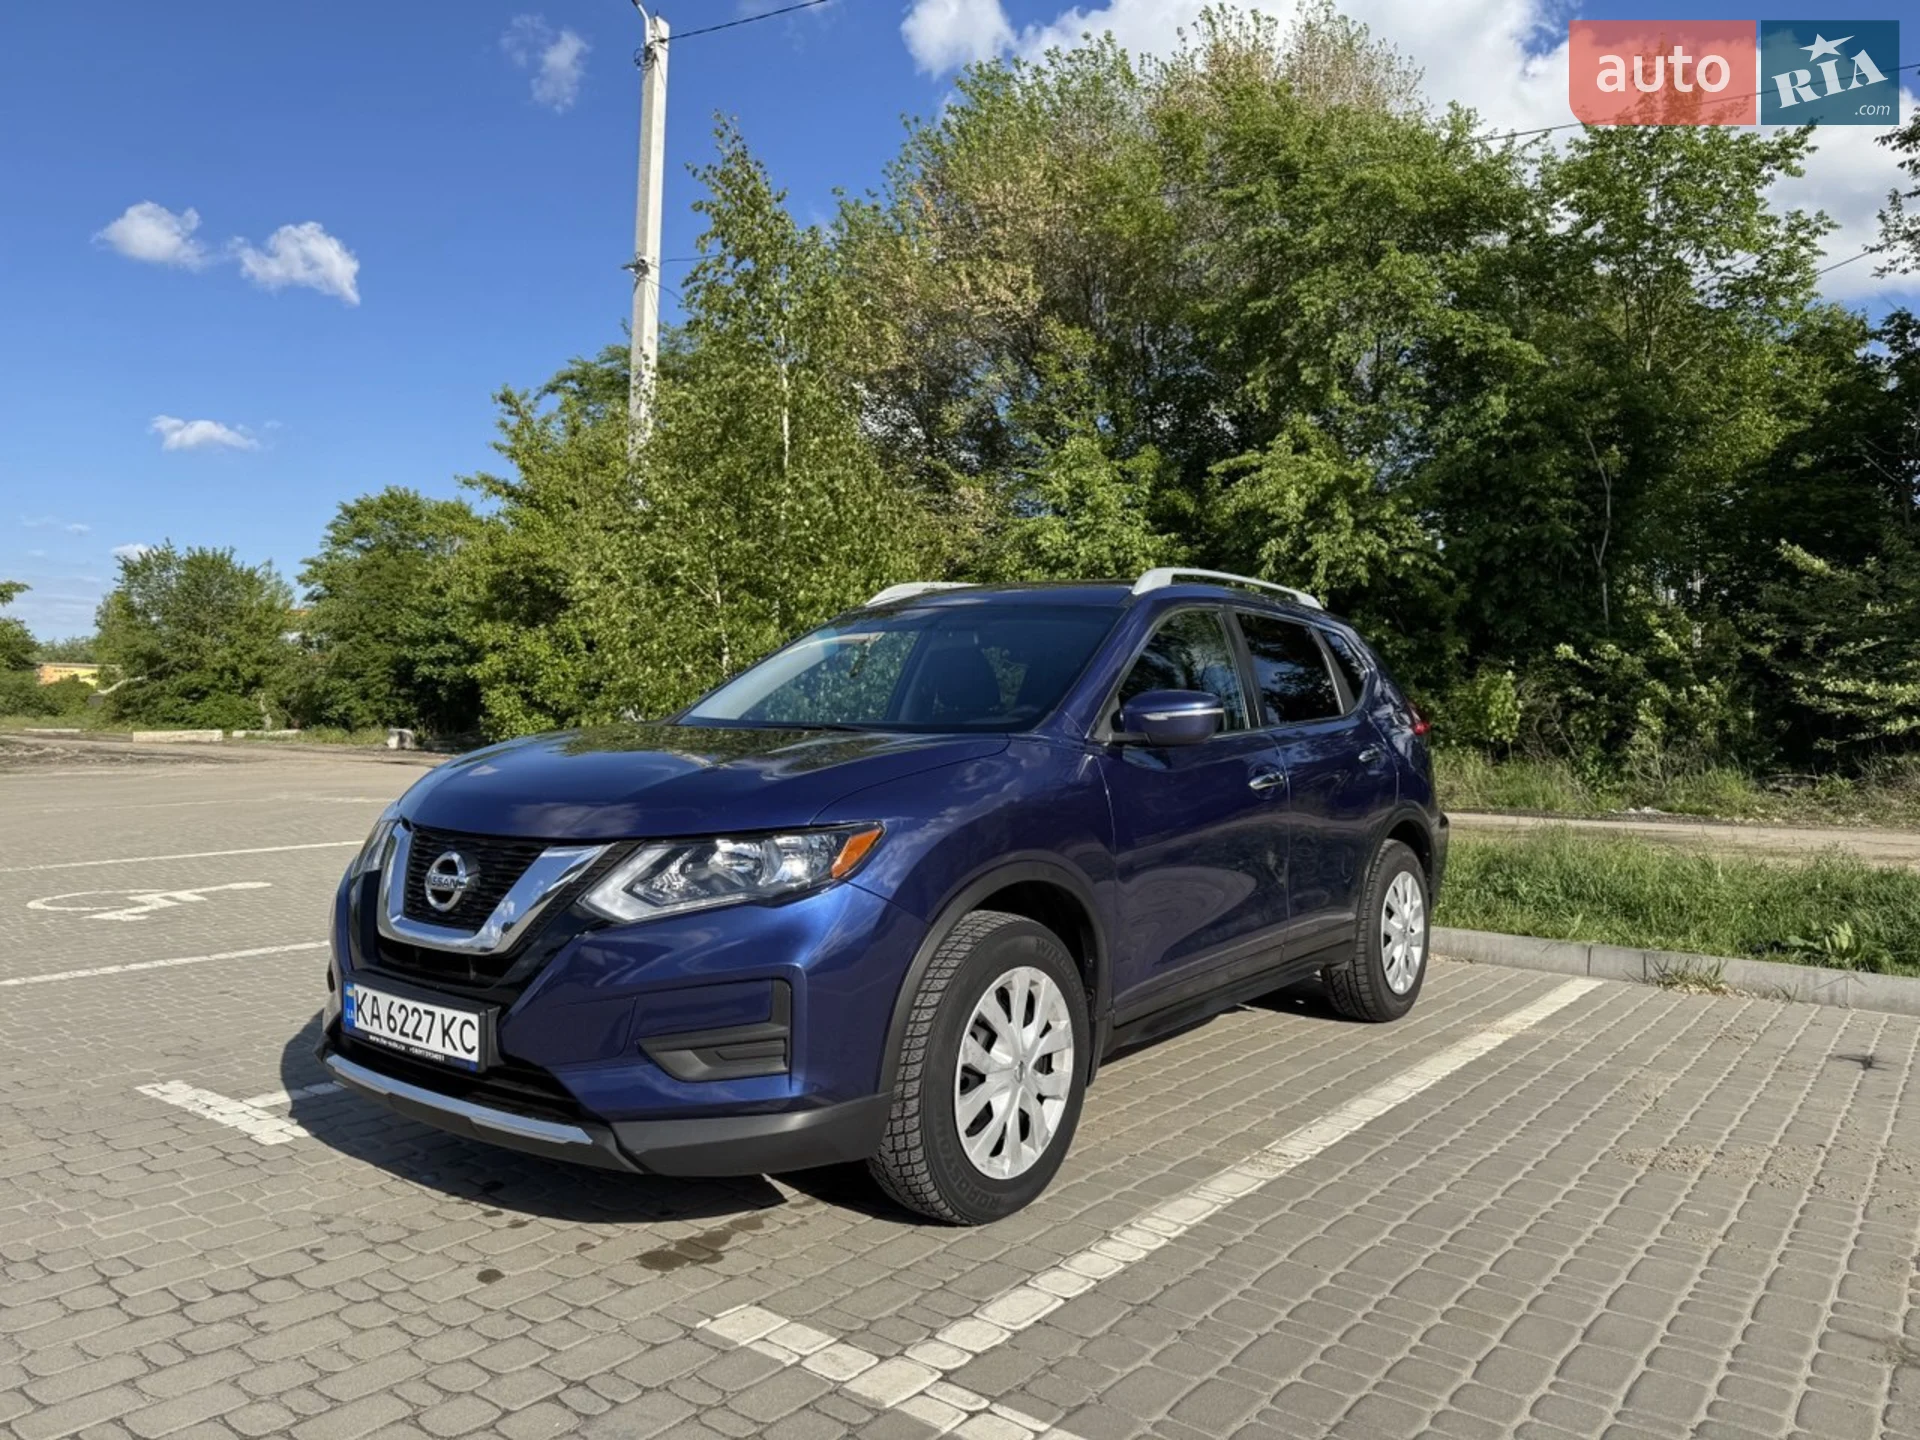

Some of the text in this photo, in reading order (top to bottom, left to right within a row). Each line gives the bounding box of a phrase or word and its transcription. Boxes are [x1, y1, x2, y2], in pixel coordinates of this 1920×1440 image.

[355, 988, 382, 1030] KA
[386, 1001, 436, 1044] 6227
[441, 1013, 476, 1055] KC
